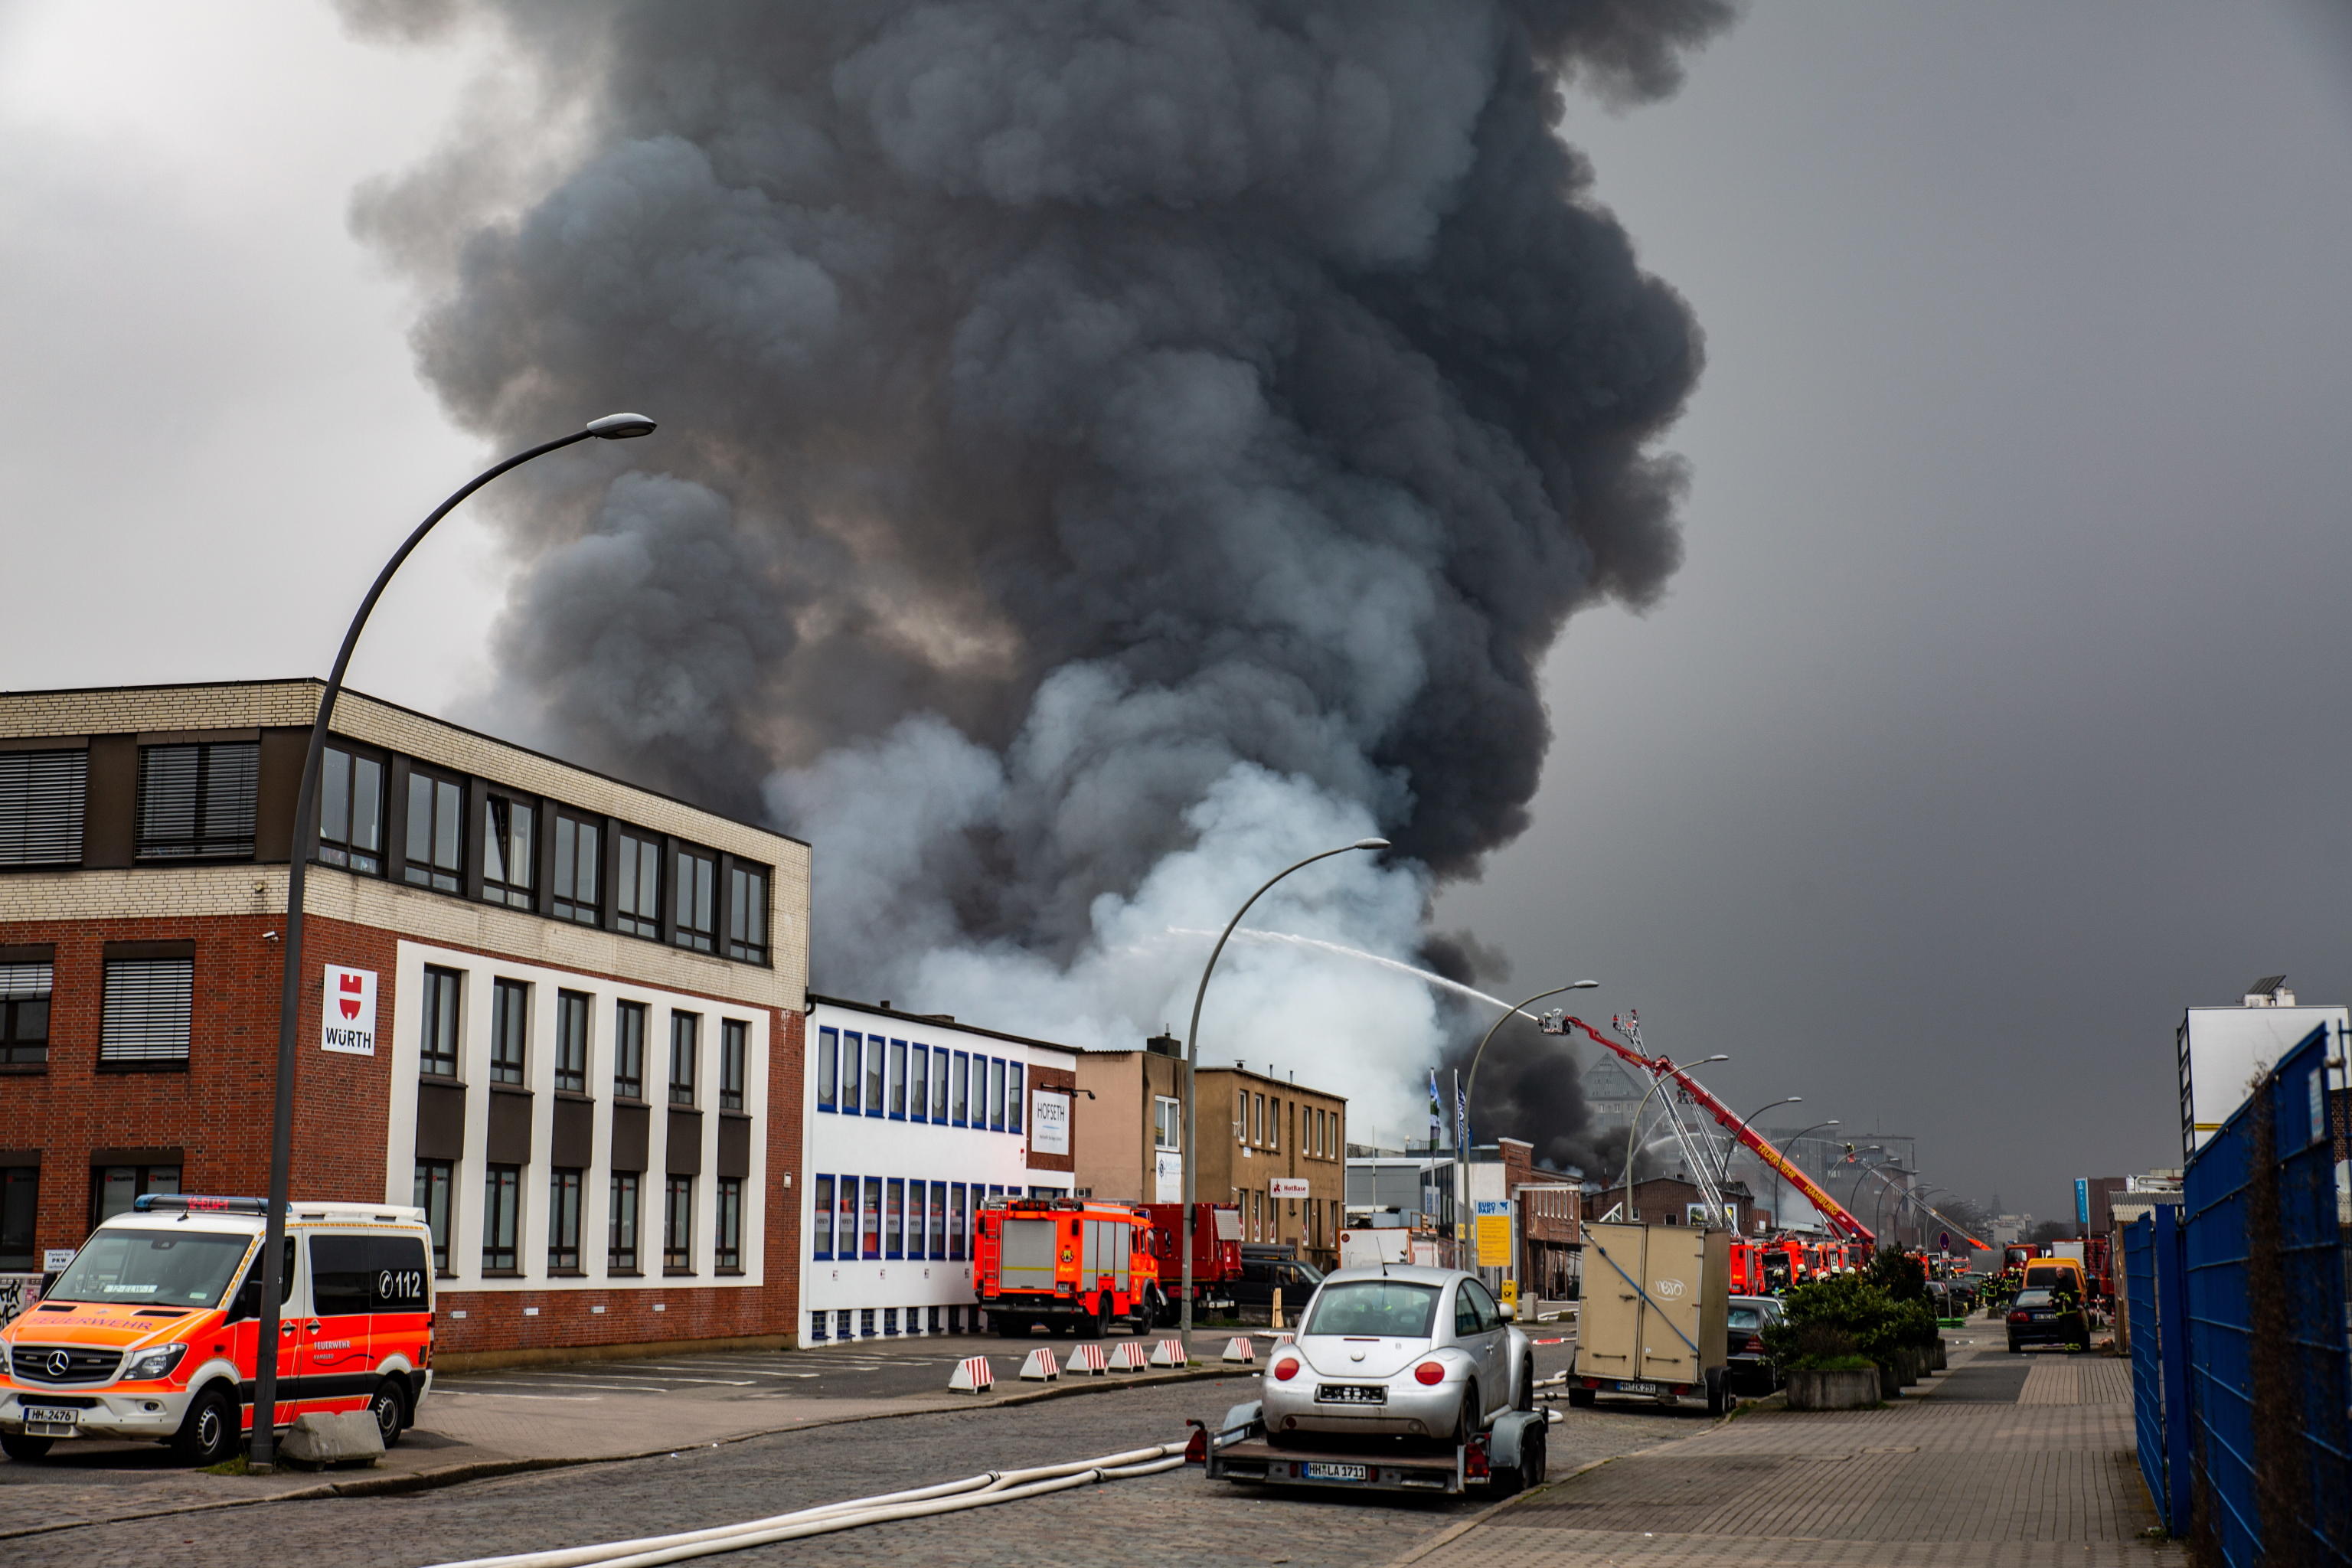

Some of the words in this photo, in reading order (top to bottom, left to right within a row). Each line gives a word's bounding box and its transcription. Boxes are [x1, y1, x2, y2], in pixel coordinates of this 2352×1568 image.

[326, 1027, 371, 1049] WÜRTH
[1037, 1102, 1065, 1122] HOFSETH
[1803, 1183, 1840, 1216] HAMBURG
[396, 1271, 420, 1298] 112
[28, 1317, 153, 1331] FEUERWEHR
[314, 1341, 351, 1350] FEUERWEHR
[32, 1410, 44, 1419] HH
[47, 1410, 71, 1421] 2476
[1309, 1464, 1321, 1475] HH
[1328, 1465, 1339, 1476] LA
[1341, 1466, 1364, 1478] 1711
